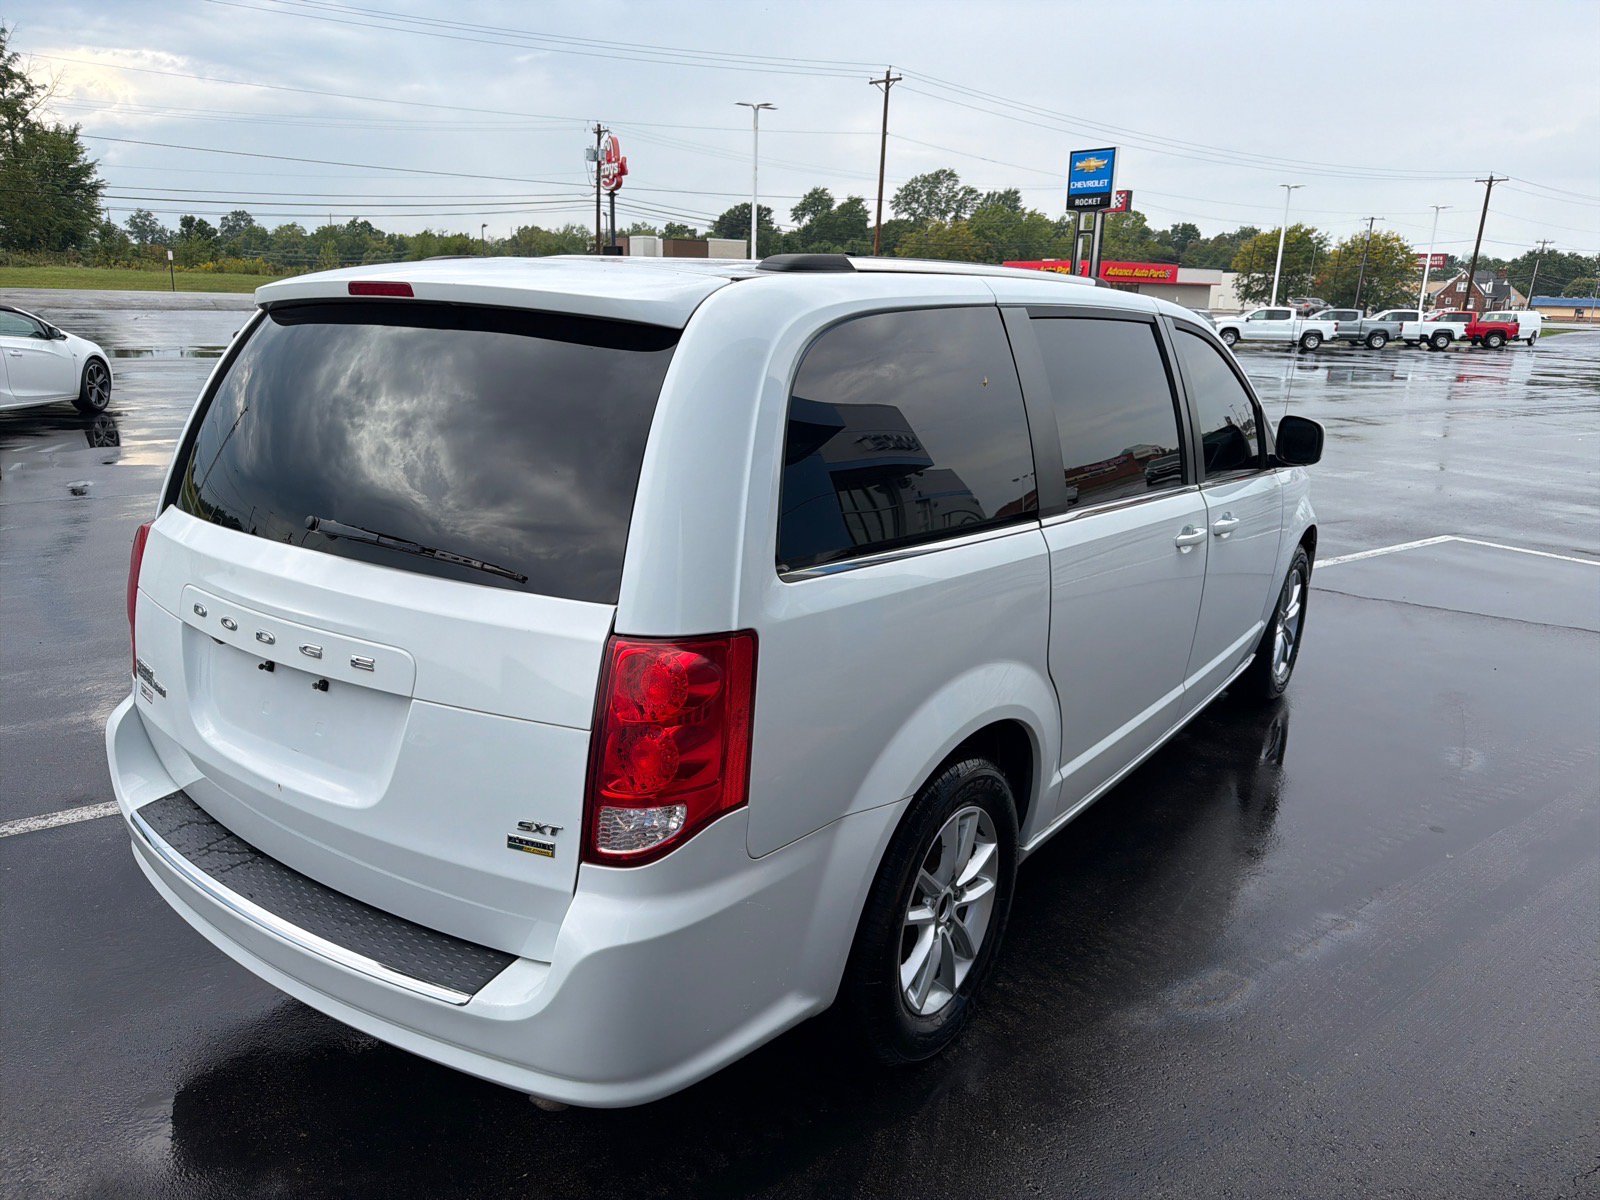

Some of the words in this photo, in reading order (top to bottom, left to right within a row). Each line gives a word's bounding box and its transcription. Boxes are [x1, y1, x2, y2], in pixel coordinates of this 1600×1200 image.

[1070, 179, 1109, 189] CHEVROLET
[1074, 197, 1101, 206] ROCKET
[1106, 267, 1133, 276] Advance
[1133, 268, 1149, 277] Auto
[1149, 269, 1166, 278] Parts
[193, 601, 375, 672] DODGE
[516, 819, 564, 836] SXT
